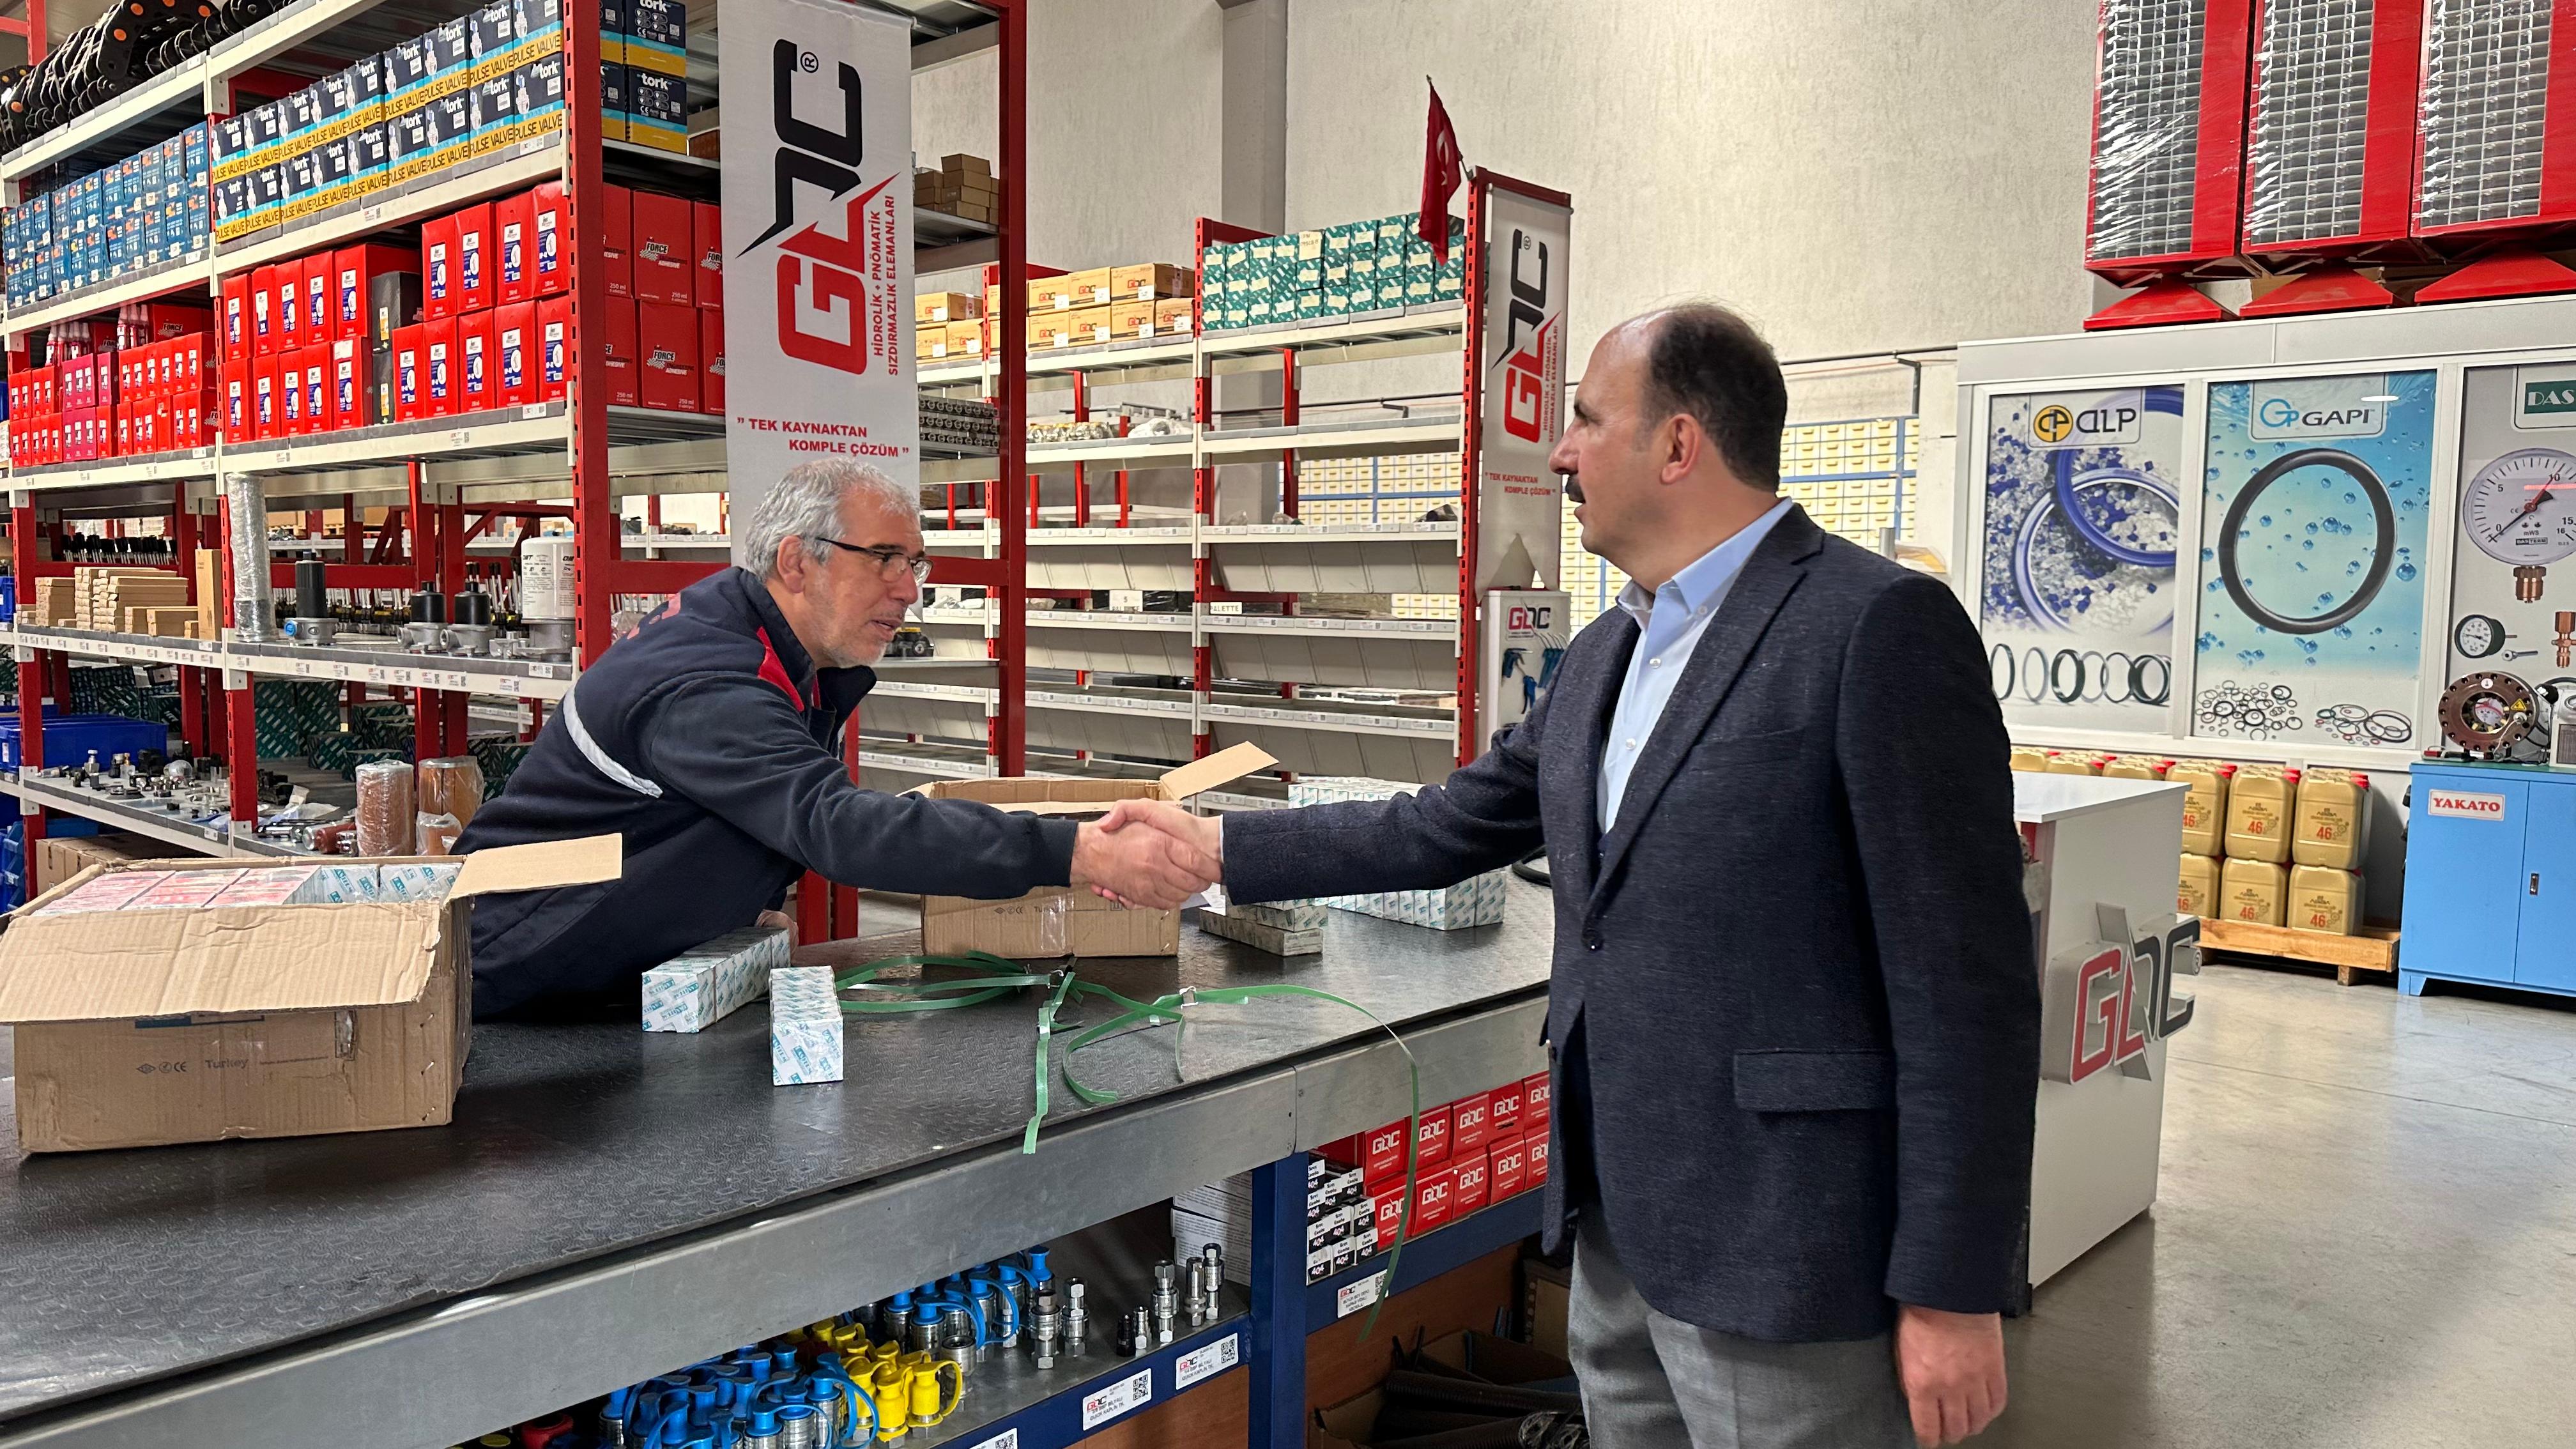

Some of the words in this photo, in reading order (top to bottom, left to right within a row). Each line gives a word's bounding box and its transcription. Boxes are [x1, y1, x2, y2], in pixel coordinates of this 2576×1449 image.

[491, 5, 508, 22] tork
[446, 25, 461, 41] tork
[404, 46, 418, 60] tork
[514, 45, 535, 63] PULSE
[537, 34, 560, 54] VALVE
[362, 62, 376, 77] tork
[470, 65, 490, 82] PULSE
[491, 56, 514, 74] VALVE
[540, 61, 558, 79] tork
[328, 79, 342, 93] tork
[425, 84, 443, 100] PULSE
[445, 73, 466, 91] VALVE
[491, 78, 508, 95] tork
[641, 73, 668, 90] tork
[294, 95, 307, 108] tork
[386, 99, 403, 116] PULSE
[404, 91, 425, 108] VALVE
[447, 97, 462, 113] tork
[260, 108, 273, 121] tork
[346, 115, 361, 132] PULSE
[363, 107, 380, 124] VALVE
[406, 113, 420, 129] tork
[225, 121, 239, 134] tork
[312, 131, 327, 146] PULSE
[328, 123, 346, 139] VALVE
[516, 122, 537, 139] PULSE
[539, 114, 562, 132] VALVE
[365, 129, 381, 144] tork
[470, 137, 489, 154] PULSE
[491, 128, 513, 146] VALVE
[279, 145, 294, 158] PULSE
[295, 137, 312, 151] VALVE
[330, 143, 343, 158] tork
[245, 155, 260, 170] PULSE
[261, 148, 279, 164] VALVE
[294, 157, 308, 171] tork
[427, 153, 445, 170] PULSE
[447, 146, 468, 162] VALVE
[212, 167, 226, 180] PULSE
[227, 160, 244, 175] VALVE
[261, 169, 275, 183] tork
[388, 167, 405, 183] PULSE
[406, 160, 426, 178] VALVE
[229, 181, 241, 194] tork
[348, 178, 365, 196] PULSE
[366, 174, 387, 190] VALVE
[312, 191, 329, 208] PULSE
[330, 187, 348, 203] VALVE
[281, 206, 295, 221] PULSE
[296, 199, 312, 214] VALVE
[247, 215, 261, 231] PULSE
[263, 210, 279, 225] VALVE
[216, 226, 229, 240] PULSE
[230, 220, 245, 236] VALVE
[885, 195, 896, 279] ELEMANLARI
[647, 243, 668, 253] FORCE
[869, 211, 882, 280] PNÖMATİK
[164, 323, 183, 332] FORCE
[870, 294, 883, 356] HİDROLİK
[887, 284, 898, 376] SIZDIRMAZLIK
[654, 351, 675, 361] FORCE
[749, 418, 778, 431] TEK
[782, 421, 867, 438] KAYNAKTAN
[789, 440, 846, 453] KOMPLE
[850, 442, 898, 457] ÇÖZÜM
[1503, 474, 1538, 483] KAYNAKTAN
[1505, 486, 1528, 494] KOMPLE
[2432, 797, 2501, 813] YAKATO
[2248, 821, 2264, 834] 46
[2317, 827, 2332, 839] 46
[2240, 907, 2255, 919] 46
[2310, 914, 2326, 927] 46
[205, 1057, 249, 1071] Turkey
